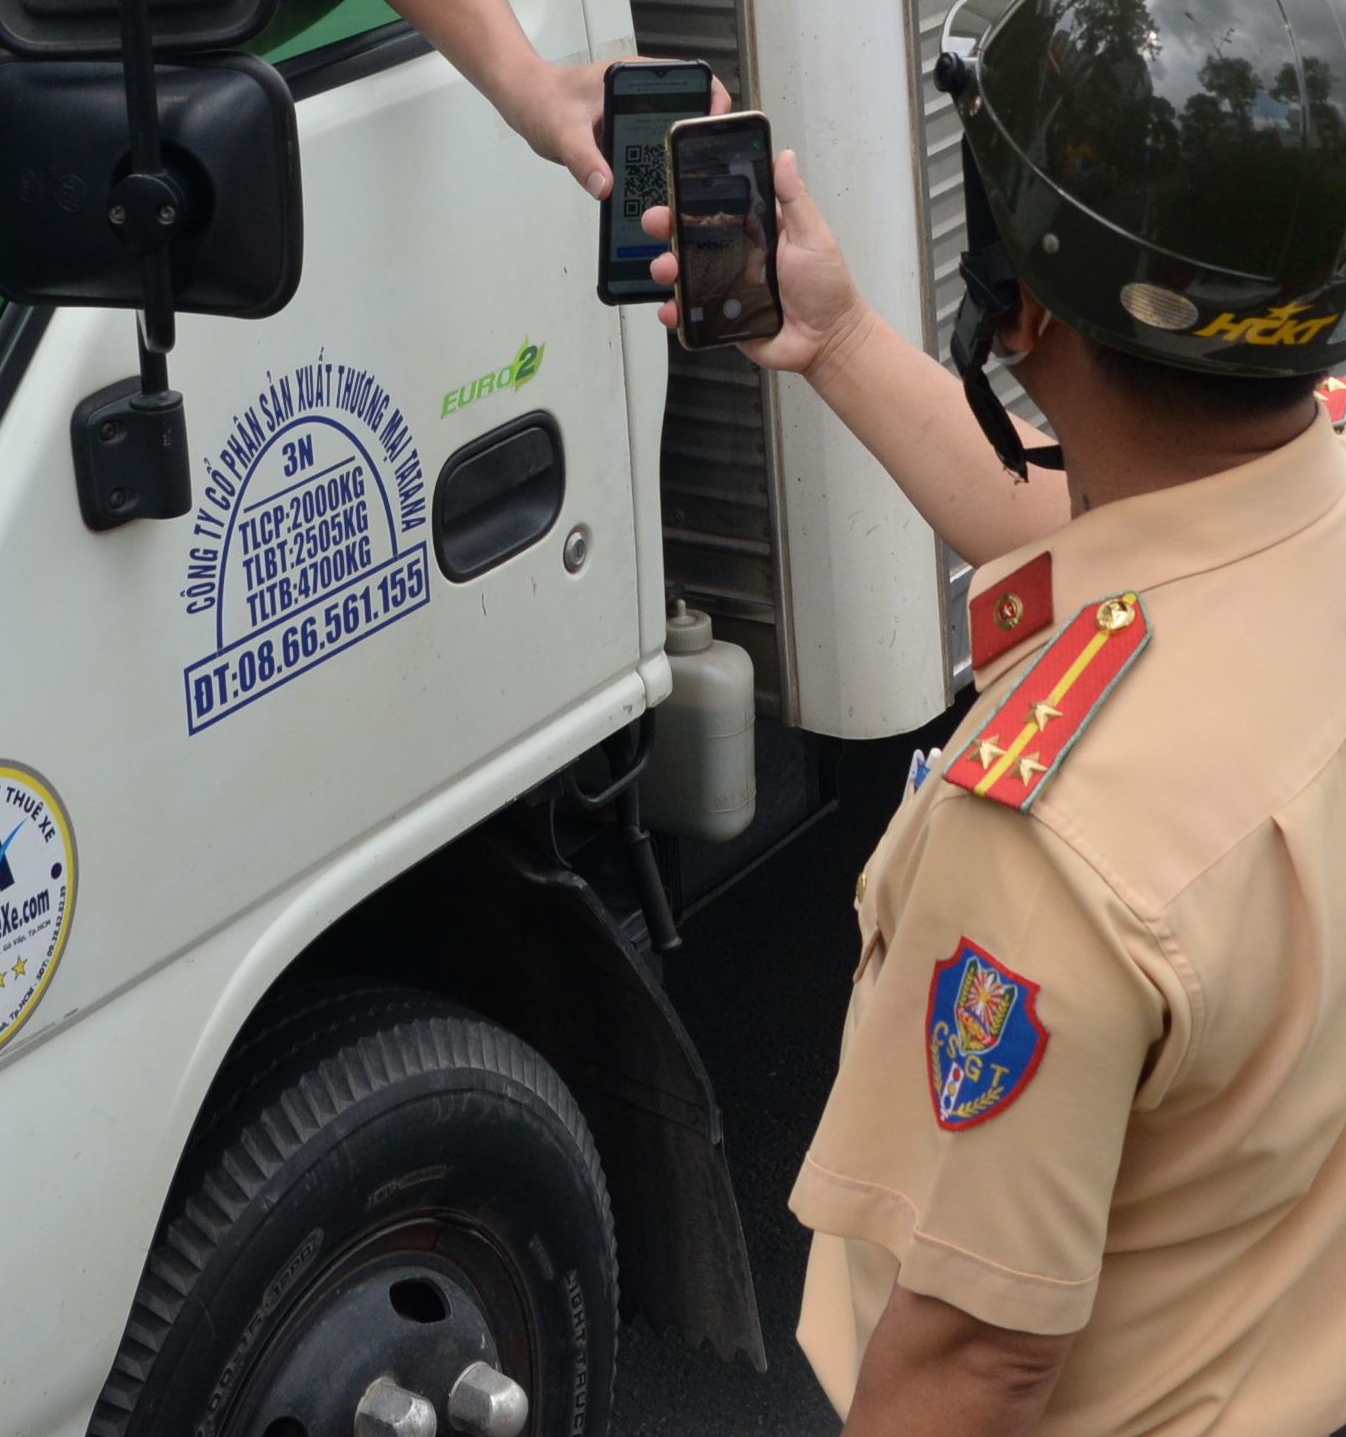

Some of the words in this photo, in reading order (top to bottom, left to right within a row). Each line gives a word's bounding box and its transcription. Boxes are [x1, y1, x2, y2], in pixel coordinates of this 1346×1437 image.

[258, 370, 295, 433] SẢN
[295, 346, 333, 413] XUẤT
[336, 364, 391, 434] THƯƠNG
[282, 433, 314, 478] 3N
[379, 408, 413, 464] MẠI
[203, 457, 236, 511] CỔ
[238, 465, 365, 556] TLCP:2000KG
[394, 447, 427, 534] TATANA
[194, 508, 225, 540] TY
[243, 500, 369, 592] TLBT:2505KG
[179, 547, 219, 615] CÔNG
[247, 534, 372, 628] TLTB:4700KG
[193, 557, 424, 719] ĐT:08.66.561.155
[5, 786, 44, 821] THUÊ
[38, 815, 56, 843] XE
[573, 1353, 589, 1437] TRUC
